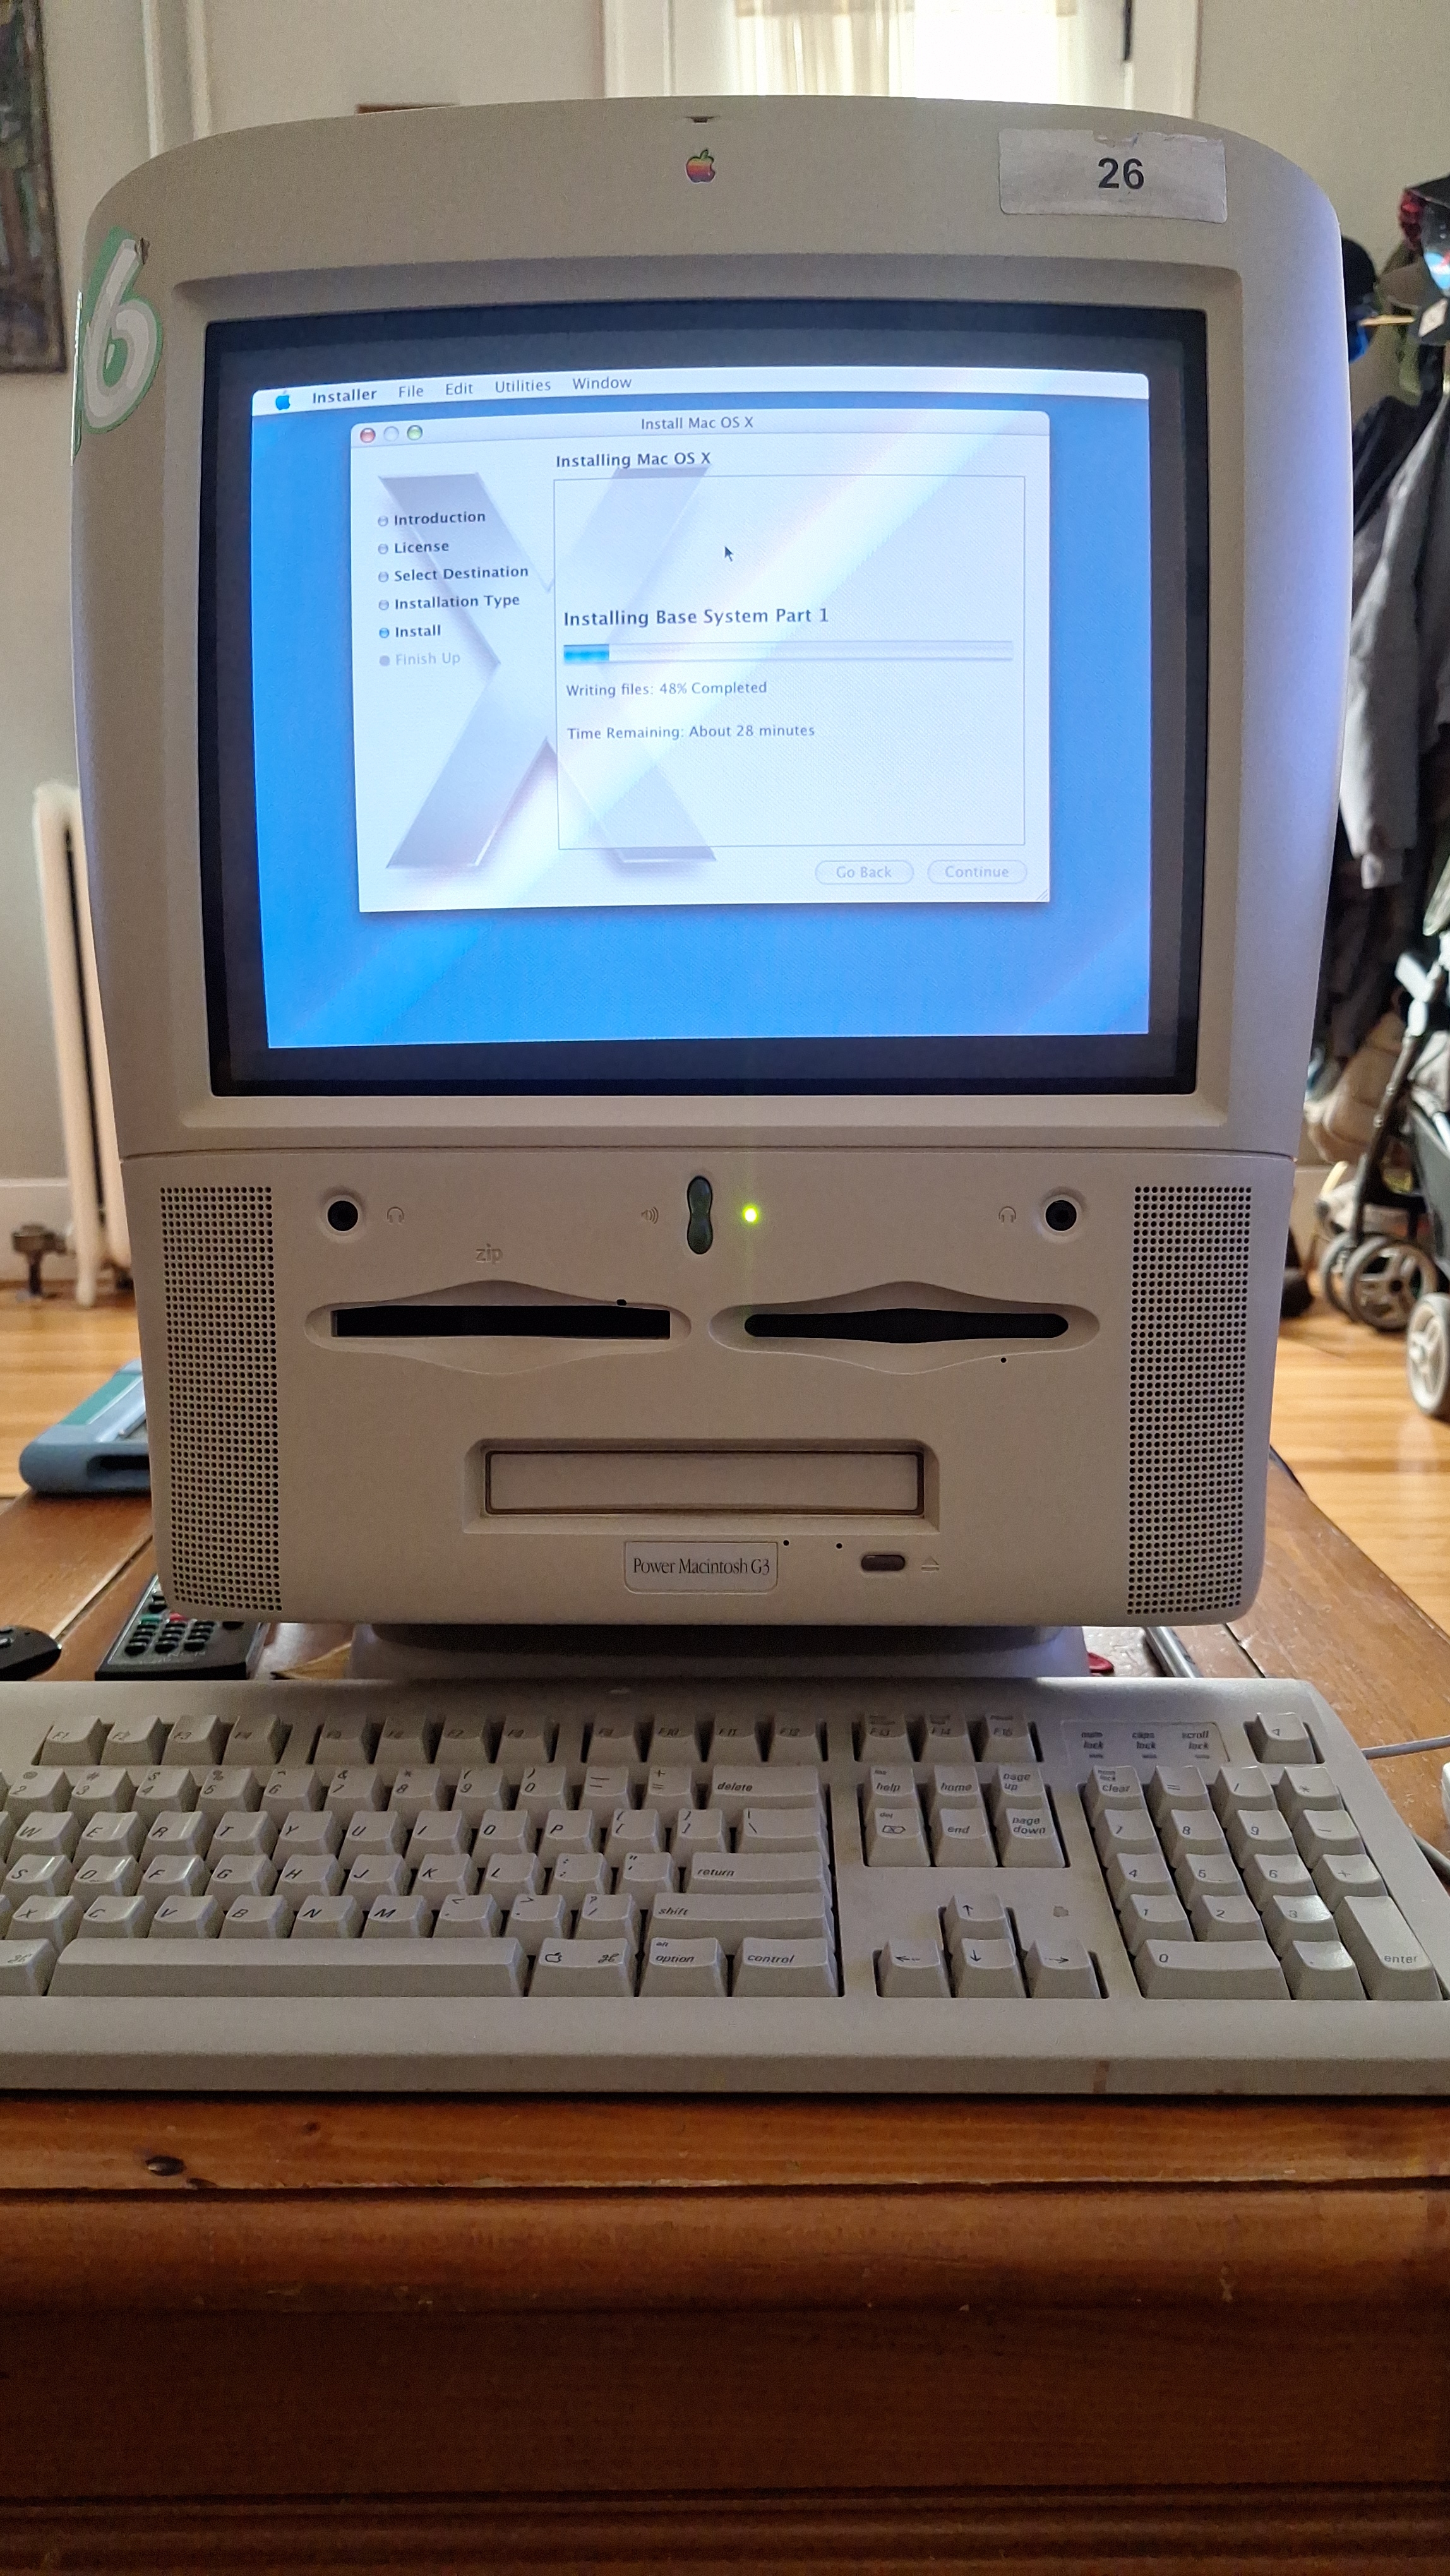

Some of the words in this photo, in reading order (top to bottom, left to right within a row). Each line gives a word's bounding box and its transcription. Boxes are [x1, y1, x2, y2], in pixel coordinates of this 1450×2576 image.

[1098, 157, 1144, 189] 26
[83, 239, 158, 429] 6
[495, 379, 551, 393] Utilities
[572, 376, 632, 390] Window
[398, 386, 424, 398] File
[445, 383, 474, 395] Edit
[313, 389, 377, 404] Installer
[641, 417, 683, 430] Install
[688, 417, 716, 429] Mac
[721, 417, 740, 428] OS
[745, 416, 753, 428] X
[556, 453, 631, 469] Installing
[637, 453, 668, 466] Mac
[674, 452, 695, 465] OS
[700, 451, 711, 464] X
[394, 511, 486, 526] Introduction
[394, 541, 450, 554] License
[394, 569, 438, 582] Select
[443, 566, 529, 580] Destination
[395, 596, 479, 610] Installation
[484, 595, 520, 609] Type
[564, 611, 649, 628] Installing
[656, 611, 698, 625] Base
[703, 609, 769, 626] System
[776, 608, 812, 623] Part
[821, 608, 829, 623] 1
[395, 624, 441, 638] Install
[395, 652, 437, 666] Finish
[442, 652, 461, 666] Up
[566, 684, 616, 698] Writing
[621, 683, 654, 695] files:
[659, 683, 687, 695] 48%
[691, 681, 767, 696] Completed
[567, 727, 601, 740] Time
[607, 726, 685, 741] Remaining:
[689, 725, 731, 737] About
[736, 725, 753, 737] 28
[759, 725, 815, 737] minutes
[836, 866, 855, 878] Go
[861, 866, 892, 878] Back
[945, 866, 1010, 878] Continue
[476, 1243, 503, 1265] zip
[633, 1558, 676, 1574] Power
[679, 1558, 748, 1575] Macintosh
[751, 1558, 770, 1575] G3
[11, 1785, 27, 1796] 2
[75, 1784, 90, 1796] 3
[141, 1786, 155, 1796] 4
[268, 1784, 282, 1795] 6
[332, 1784, 344, 1794] 7
[396, 1784, 409, 1794] 8
[460, 1783, 472, 1794] 9
[524, 1782, 536, 1793] 0
[717, 1782, 753, 1792] delete
[875, 1782, 901, 1792] help
[940, 1782, 973, 1792] home
[1004, 1782, 1018, 1791] up
[1102, 1783, 1130, 1794] clear
[1012, 1816, 1040, 1826] page
[18, 1826, 43, 1839] W
[86, 1827, 103, 1839] E
[152, 1827, 169, 1837] R
[219, 1826, 234, 1837] T
[285, 1825, 299, 1836] Y
[352, 1826, 367, 1837] U
[417, 1825, 428, 1835] I
[484, 1824, 496, 1835] O
[550, 1824, 564, 1835] P
[947, 1825, 971, 1834] end
[1012, 1825, 1046, 1835] down
[1182, 1825, 1191, 1836] 8
[1250, 1826, 1260, 1836] 9
[11, 1869, 28, 1880] S
[79, 1869, 98, 1880] D
[148, 1869, 166, 1880] F
[217, 1869, 233, 1880] G
[284, 1869, 303, 1880] H
[354, 1869, 369, 1880] J
[422, 1868, 438, 1878] K
[491, 1867, 501, 1878] L
[697, 1867, 735, 1878] return
[1129, 1869, 1137, 1878] 4
[1198, 1869, 1206, 1878] 5
[1269, 1869, 1278, 1879] 6
[16, 1908, 38, 1919] X
[88, 1908, 105, 1918] C
[160, 1909, 178, 1918] V
[231, 1909, 249, 1918] B
[303, 1908, 323, 1918] N
[373, 1908, 397, 1917] M
[658, 1906, 689, 1916] shift
[1143, 1909, 1149, 1917] 1
[1216, 1909, 1226, 1919] 2
[1288, 1910, 1298, 1919] 3
[656, 1955, 695, 1964] option
[747, 1954, 795, 1964] control
[1384, 1955, 1418, 1964] enter
